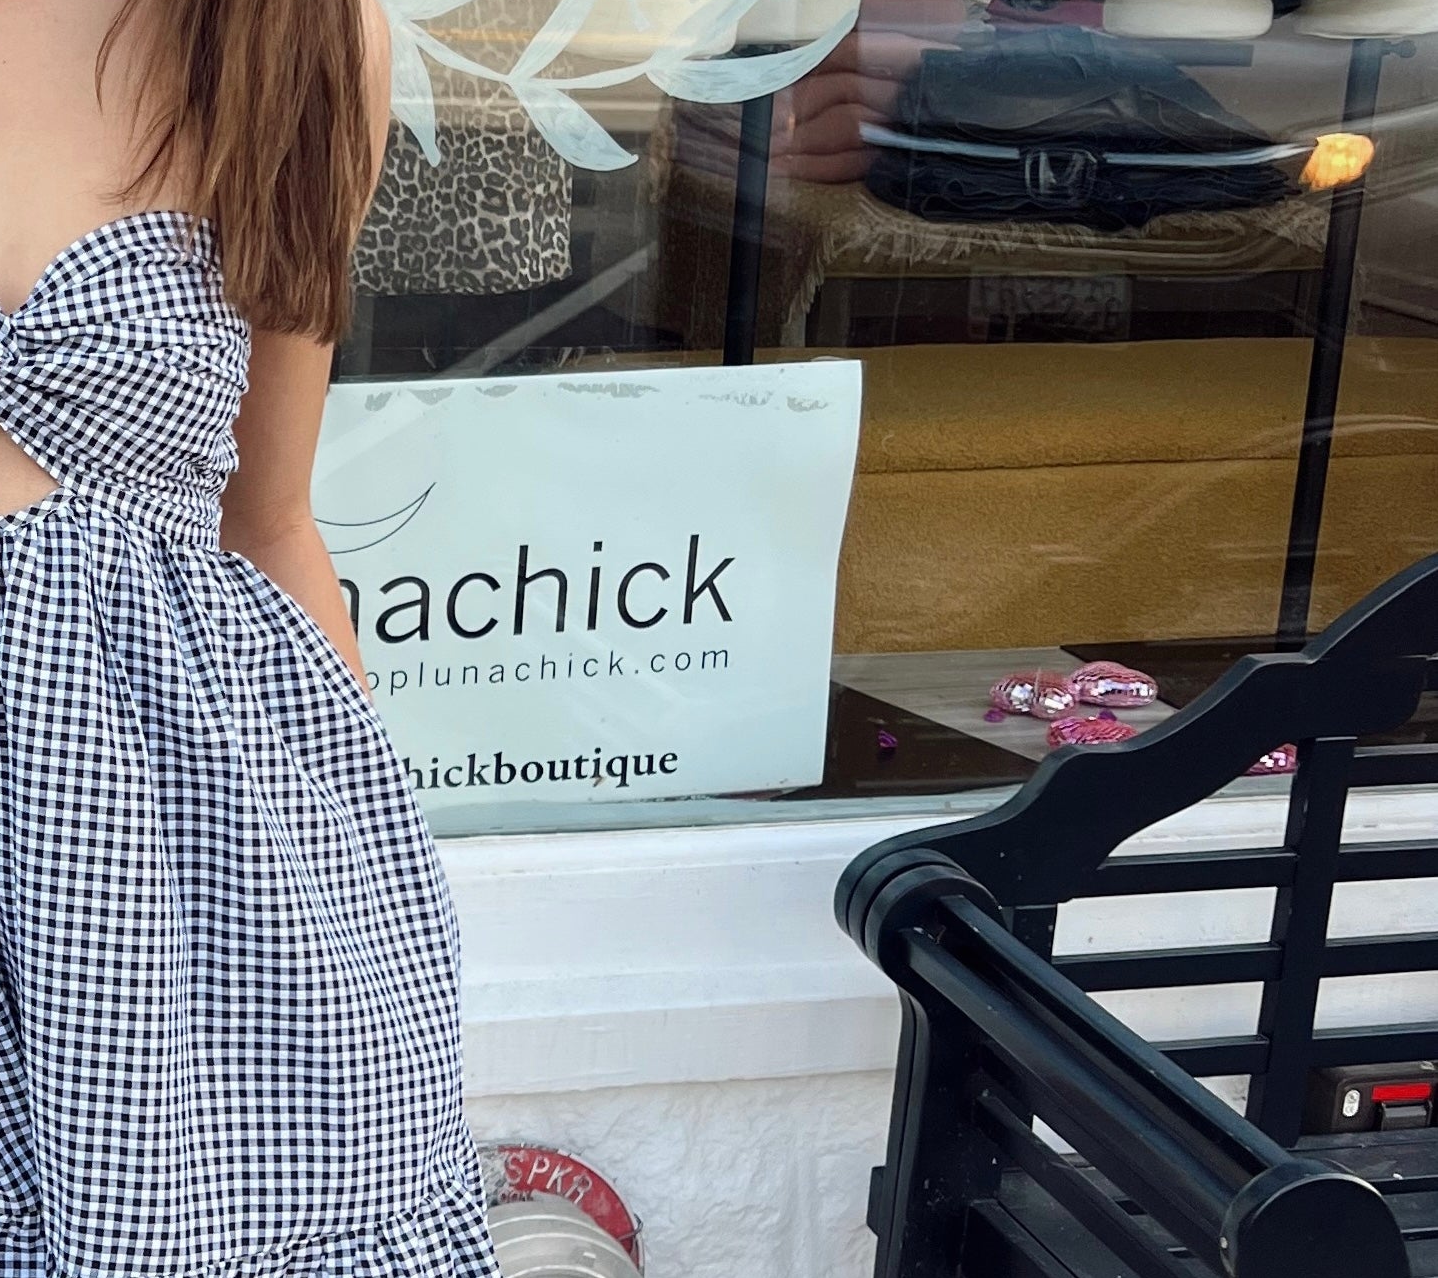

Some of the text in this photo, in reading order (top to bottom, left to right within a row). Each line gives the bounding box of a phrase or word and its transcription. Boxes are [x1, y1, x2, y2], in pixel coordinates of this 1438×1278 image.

[364, 648, 729, 697] oplunachick.com
[401, 746, 679, 790] hickboutique
[503, 1152, 593, 1205] SPKR
